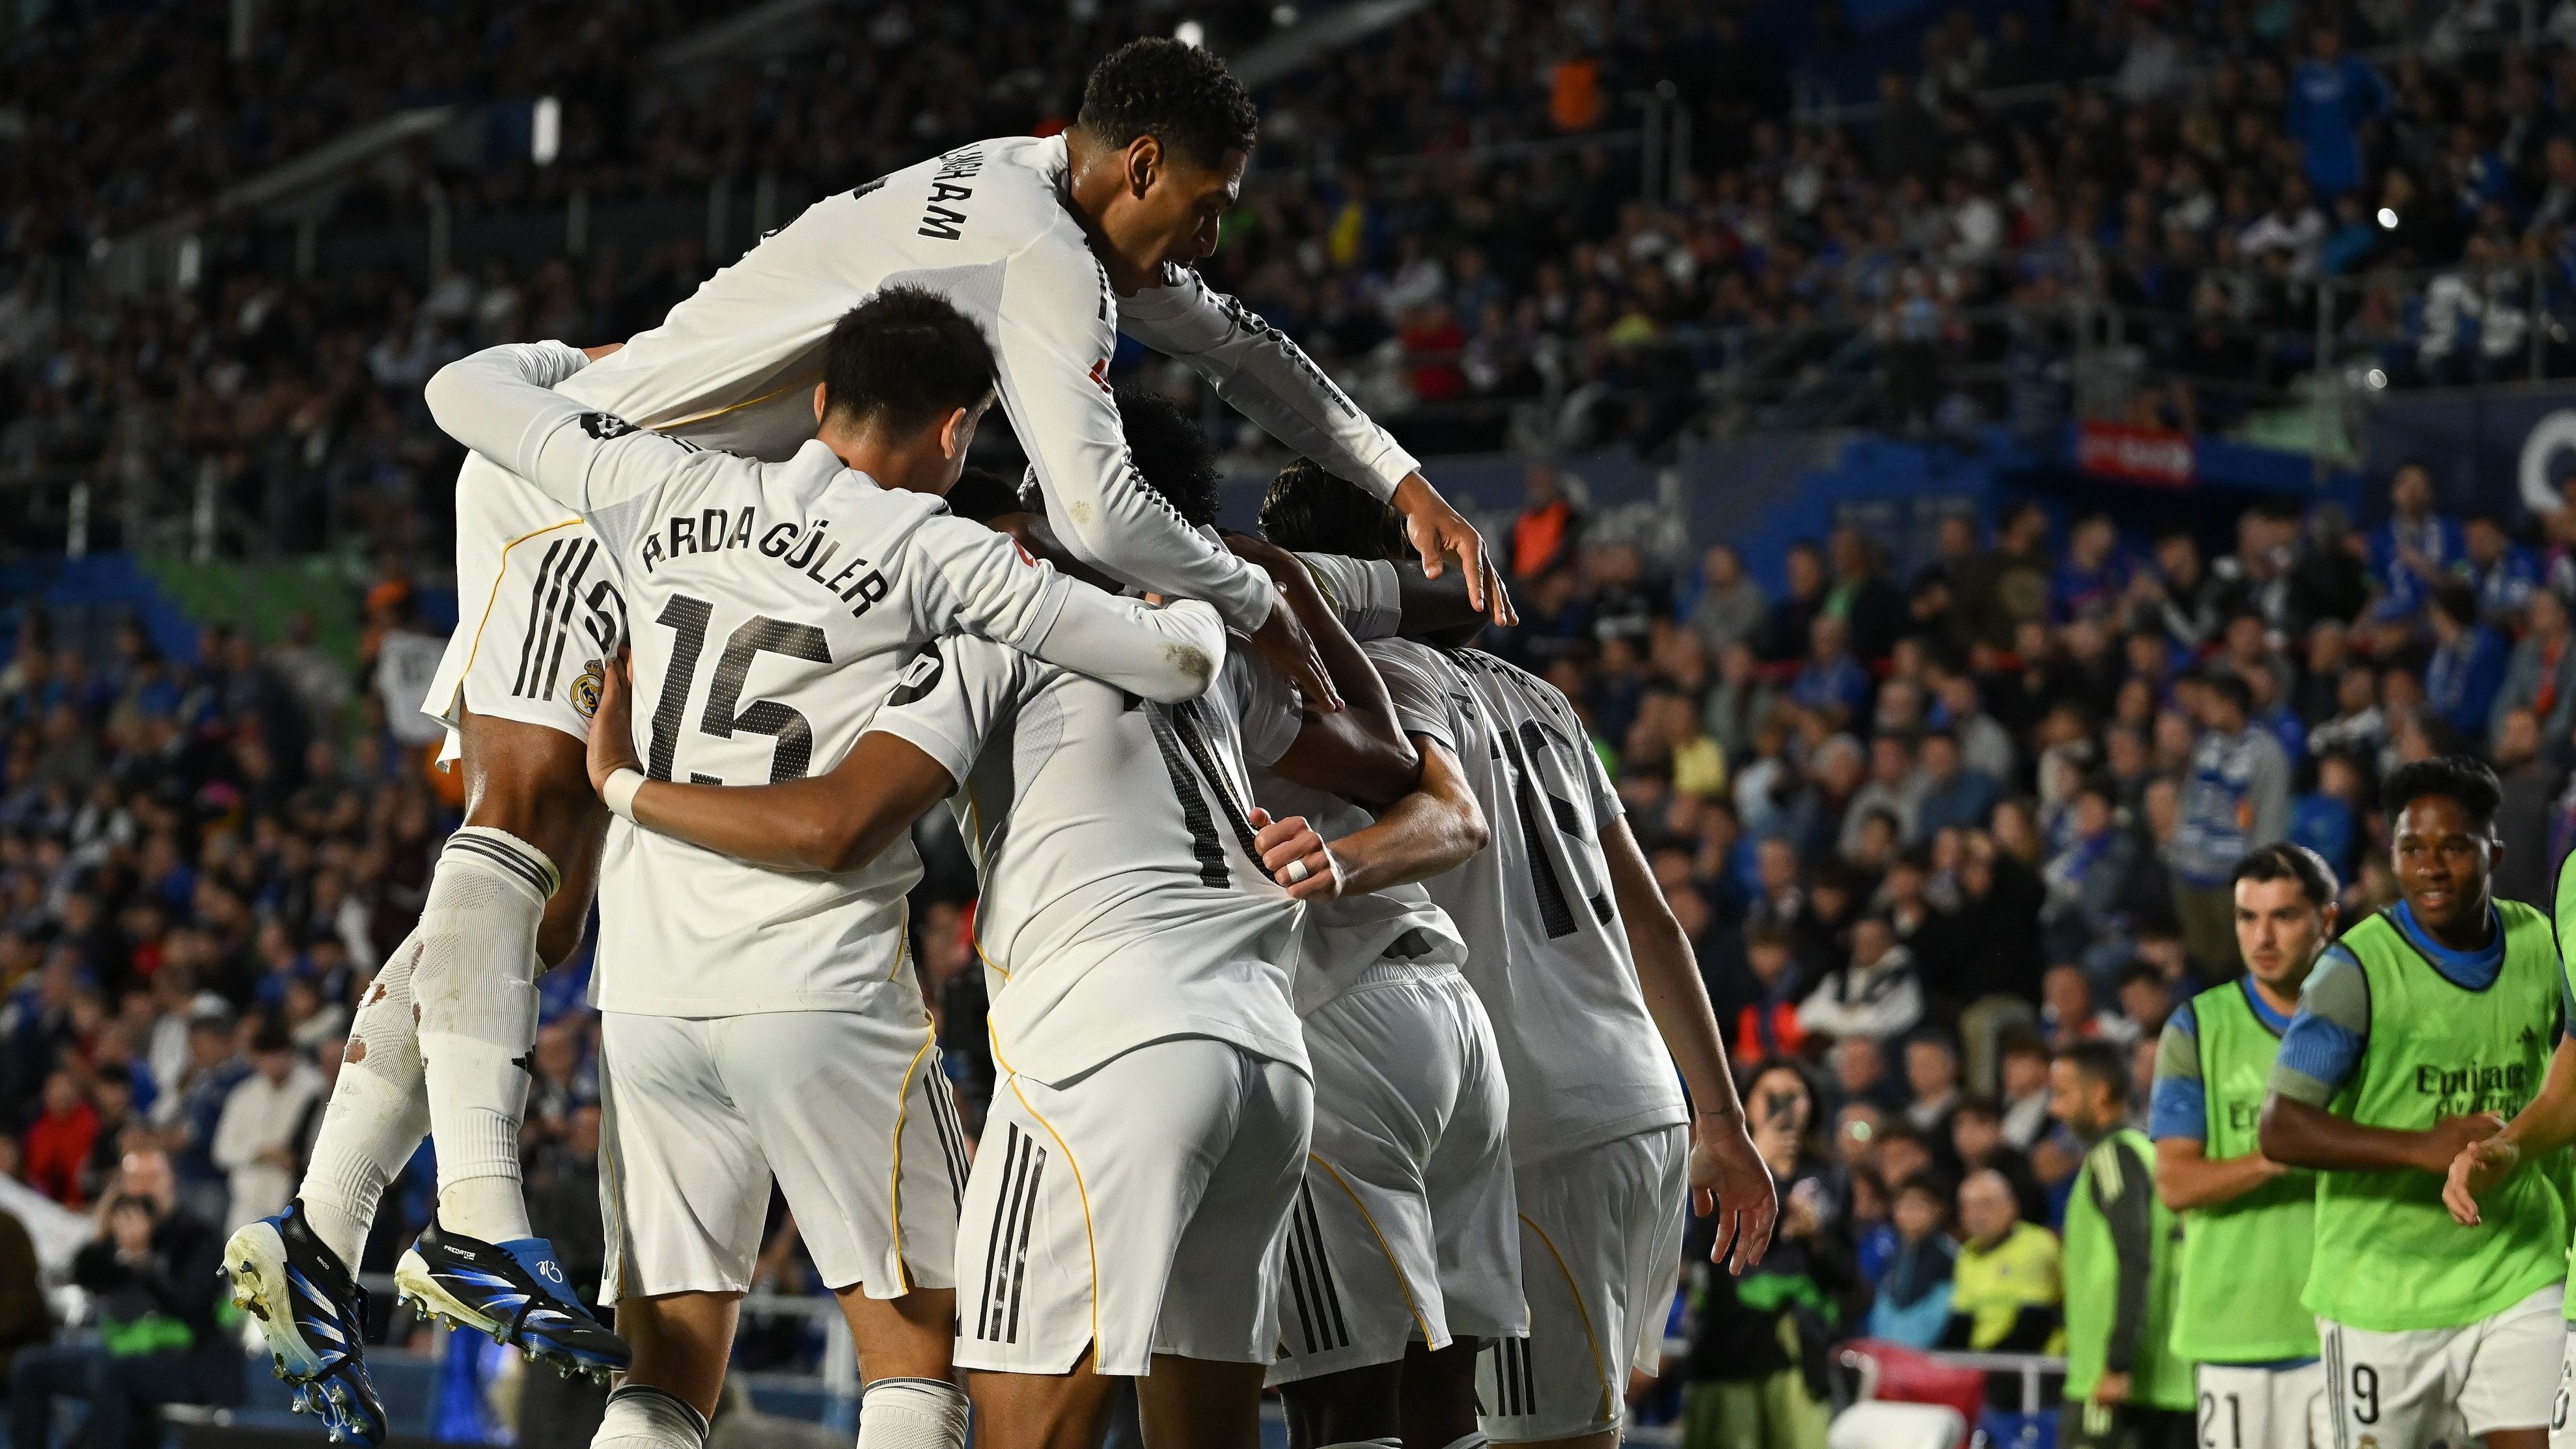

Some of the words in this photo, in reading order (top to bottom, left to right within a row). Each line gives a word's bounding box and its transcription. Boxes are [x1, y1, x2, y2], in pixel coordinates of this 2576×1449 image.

[917, 143, 983, 240] LINGHAM
[641, 506, 755, 573] ARDA
[758, 519, 889, 619] GÜLER
[646, 592, 833, 786] 15
[444, 1245, 476, 1258] PREDATOR
[2200, 1391, 2241, 1448] 21
[2352, 1362, 2379, 1425] 9
